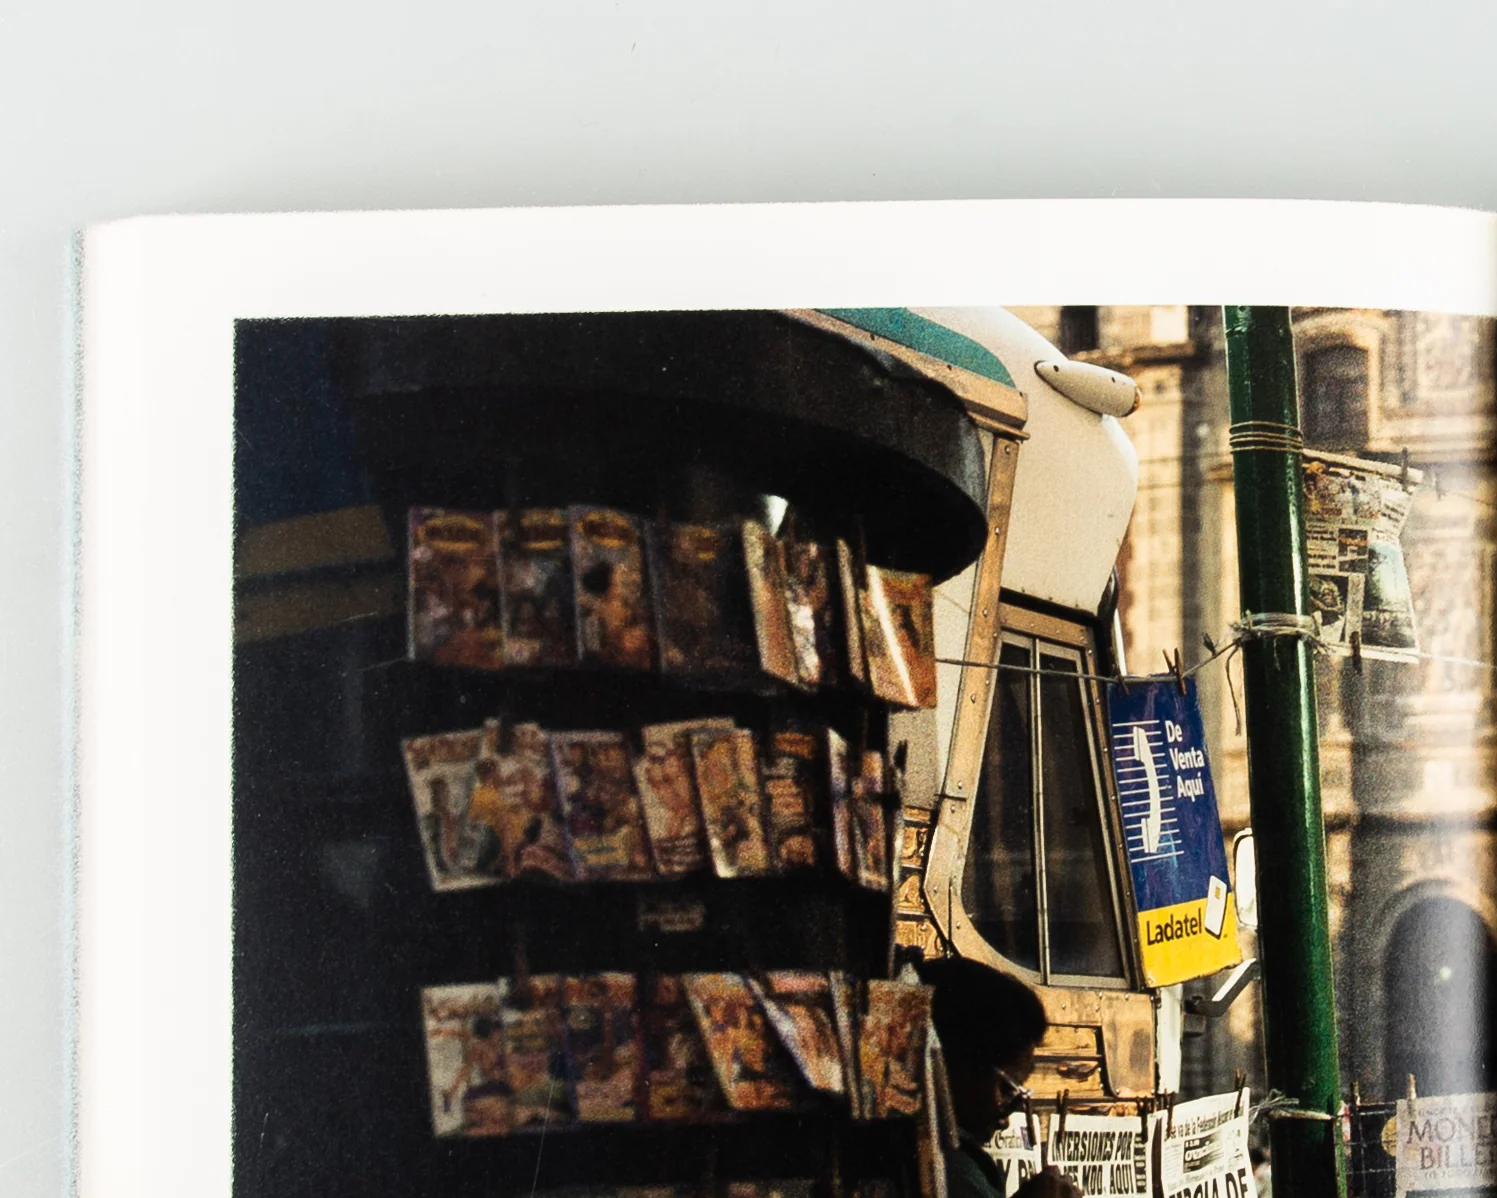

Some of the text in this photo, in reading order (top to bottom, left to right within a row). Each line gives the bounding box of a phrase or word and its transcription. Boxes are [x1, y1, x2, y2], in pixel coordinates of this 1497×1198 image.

[1165, 719, 1183, 743] De
[1169, 747, 1206, 771] Venta
[1147, 908, 1203, 946] Ladatel
[1115, 1131, 1133, 1161] POR
